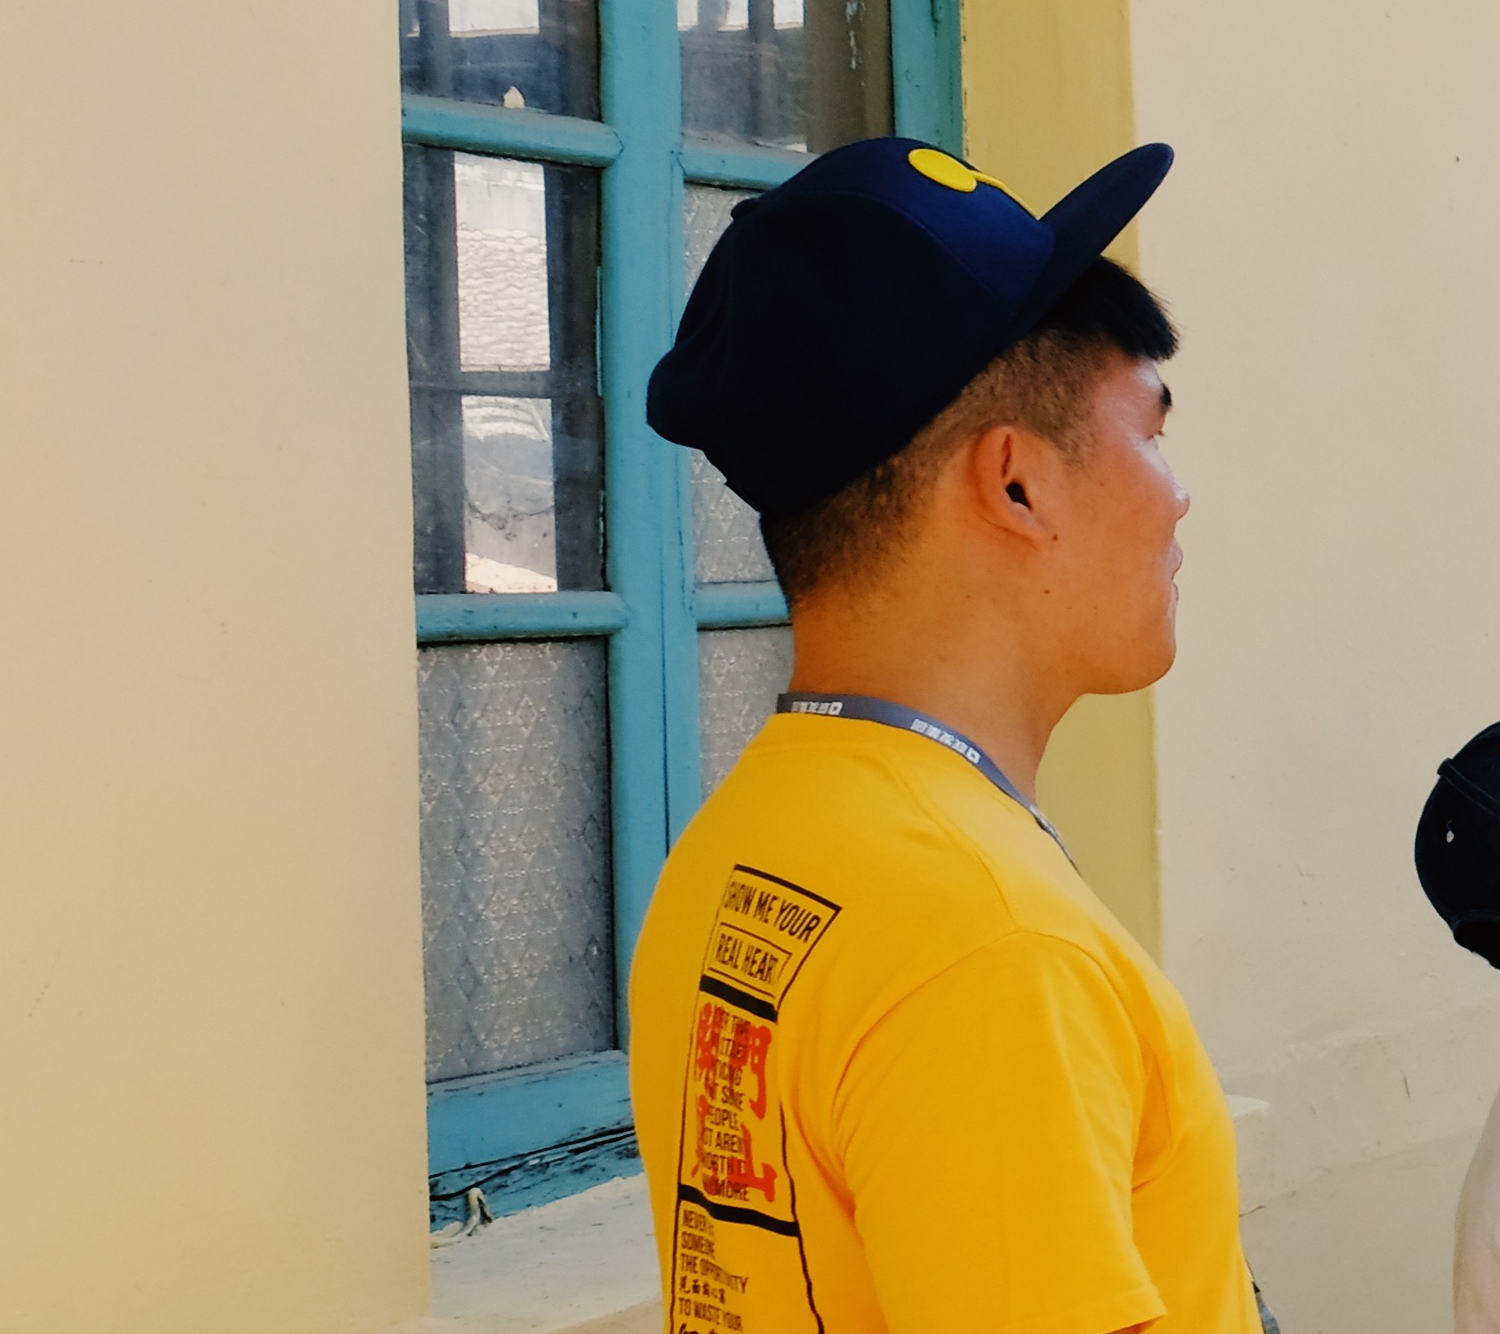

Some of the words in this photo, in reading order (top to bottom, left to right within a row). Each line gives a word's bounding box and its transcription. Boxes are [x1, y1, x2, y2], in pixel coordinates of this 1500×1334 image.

[753, 890, 780, 924] ME
[773, 899, 822, 944] YOUR
[714, 932, 744, 970] REAL
[679, 1297, 692, 1317] TO
